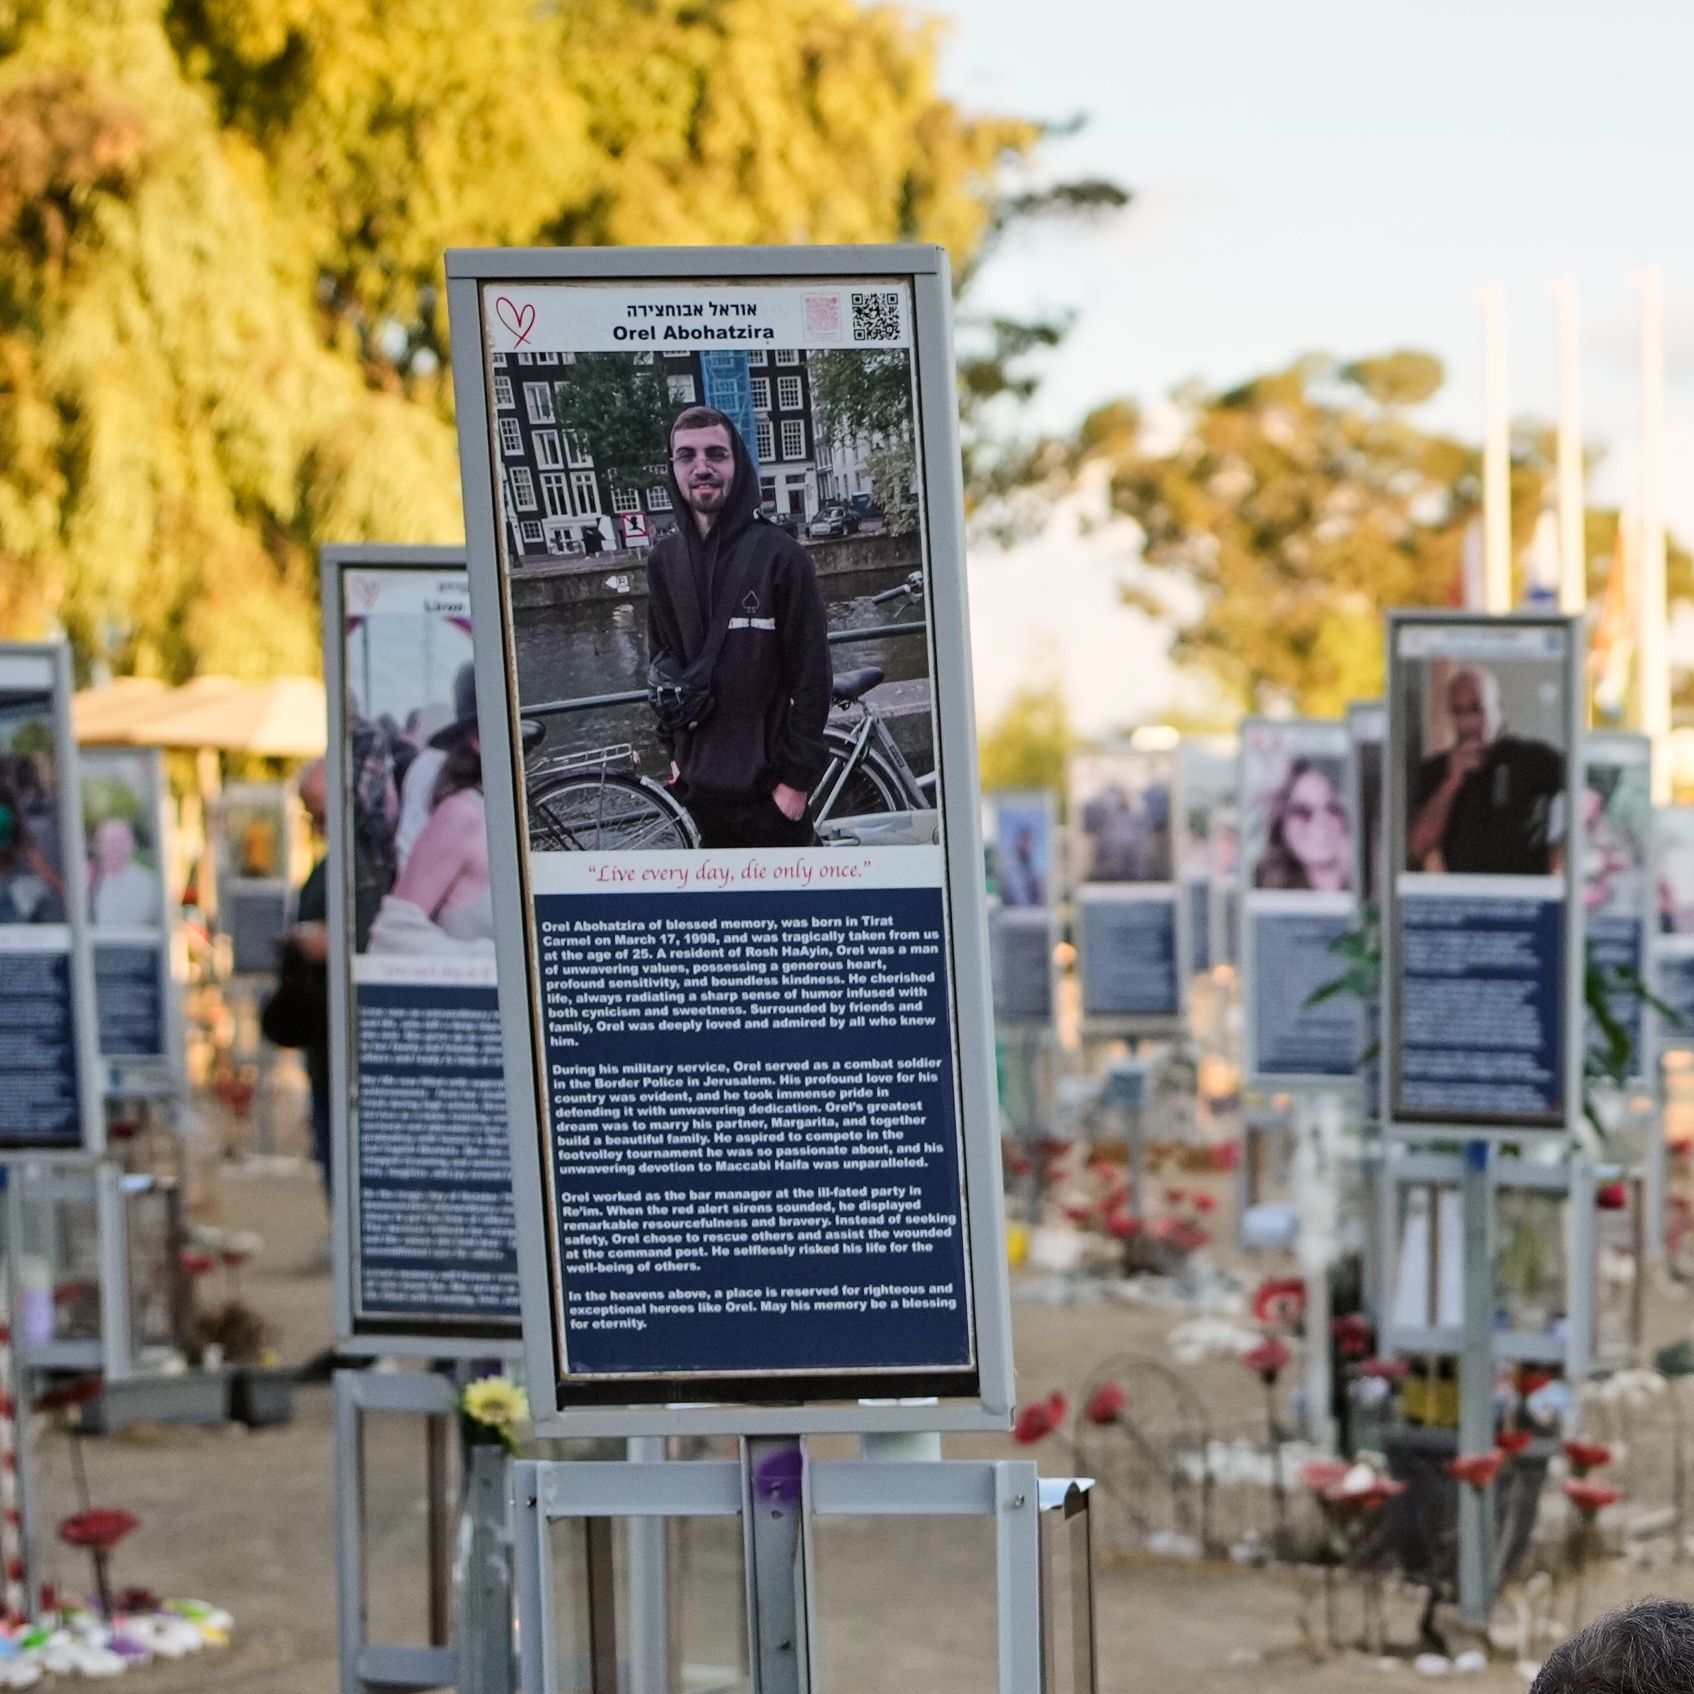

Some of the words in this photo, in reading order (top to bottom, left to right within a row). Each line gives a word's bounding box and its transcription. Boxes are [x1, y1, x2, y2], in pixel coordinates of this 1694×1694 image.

[627, 304, 703, 317] אבוחצירה
[708, 301, 757, 317] אוראל
[613, 326, 656, 341] Orel
[663, 324, 775, 340] Abohatzira
[641, 867, 689, 889] every
[695, 859, 735, 888] day,
[741, 858, 767, 879] die
[773, 857, 813, 887] only
[540, 920, 572, 933] Orel
[572, 919, 647, 932] Abohatzira
[647, 919, 664, 931] of
[664, 918, 719, 931] blessed
[719, 919, 779, 931] memory,
[779, 918, 810, 929] was
[810, 916, 844, 928] born
[844, 915, 860, 927] in
[859, 915, 895, 927] Tirat
[541, 934, 593, 947] Carmel
[593, 937, 613, 946] on
[613, 934, 658, 946] March
[658, 933, 682, 946] 17,
[722, 932, 749, 944] and
[750, 933, 780, 943] was
[780, 930, 847, 945] tragically
[847, 930, 887, 942] taken
[887, 929, 921, 941] from
[922, 930, 941, 940] us
[542, 950, 559, 961] at
[559, 949, 585, 961] the
[585, 951, 613, 963] age
[613, 948, 630, 960] of
[631, 948, 654, 960] 25.
[655, 947, 668, 959] A
[668, 947, 726, 959] resident
[726, 946, 743, 958] of
[744, 945, 780, 958] Rosh
[834, 944, 866, 956] Orel
[866, 945, 896, 955] was
[897, 945, 908, 955] a
[909, 945, 940, 955] man
[558, 1162, 637, 1176] unwavering
[637, 1161, 696, 1173] devotion
[697, 1161, 714, 1172] to
[714, 1159, 773, 1172] Maccabi
[773, 1158, 811, 1171] Haifa
[811, 1160, 841, 1170] was
[841, 1156, 930, 1171] unparalleled.
[567, 1290, 583, 1302] In
[583, 1290, 608, 1302] the
[608, 1290, 666, 1301] heavens
[666, 1288, 712, 1301] above,
[713, 1289, 724, 1299] a
[724, 1287, 764, 1301] place
[764, 1286, 779, 1298] is
[779, 1285, 840, 1298] reserved
[840, 1284, 862, 1296] for
[862, 1284, 927, 1298] righteous
[927, 1282, 955, 1294] and
[568, 1303, 648, 1317] exceptional
[648, 1303, 696, 1314] heroes
[696, 1301, 724, 1313] like
[724, 1301, 759, 1313] Orel.
[759, 1300, 789, 1314] May
[789, 1300, 812, 1311] his
[812, 1300, 869, 1313] memory
[869, 1298, 888, 1310] be
[889, 1300, 901, 1309] a
[900, 1296, 958, 1310] blessing
[568, 1318, 591, 1330] for
[590, 1317, 649, 1331] eternity.
